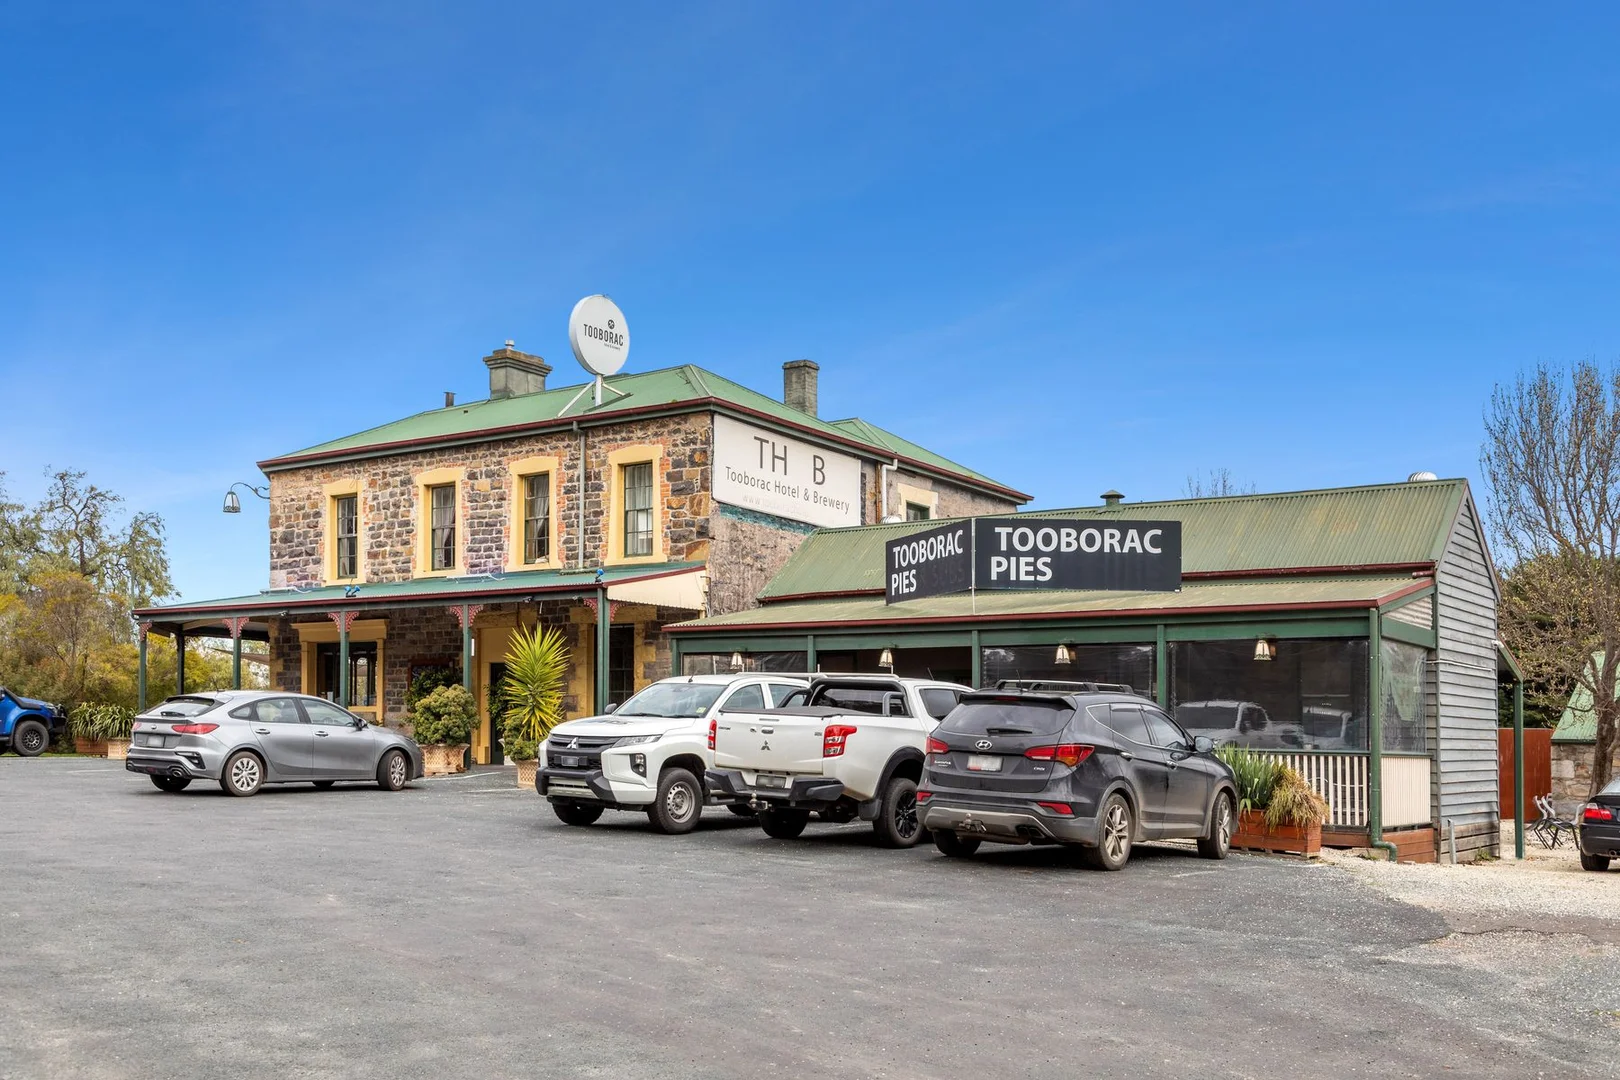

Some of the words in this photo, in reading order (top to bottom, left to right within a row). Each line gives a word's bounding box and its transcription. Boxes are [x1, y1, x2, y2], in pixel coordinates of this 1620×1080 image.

[583, 323, 624, 347] TOOBORAC
[754, 436, 788, 476] TH
[813, 454, 826, 486] B
[725, 466, 771, 492] Tooborac
[774, 480, 800, 499] Hotel
[803, 488, 810, 501] &
[813, 491, 850, 515] Brewery
[892, 529, 964, 569] TOOBORAC
[994, 527, 1163, 554] TOOBORAC
[891, 569, 917, 596] PIES
[990, 556, 1053, 582] PIES
